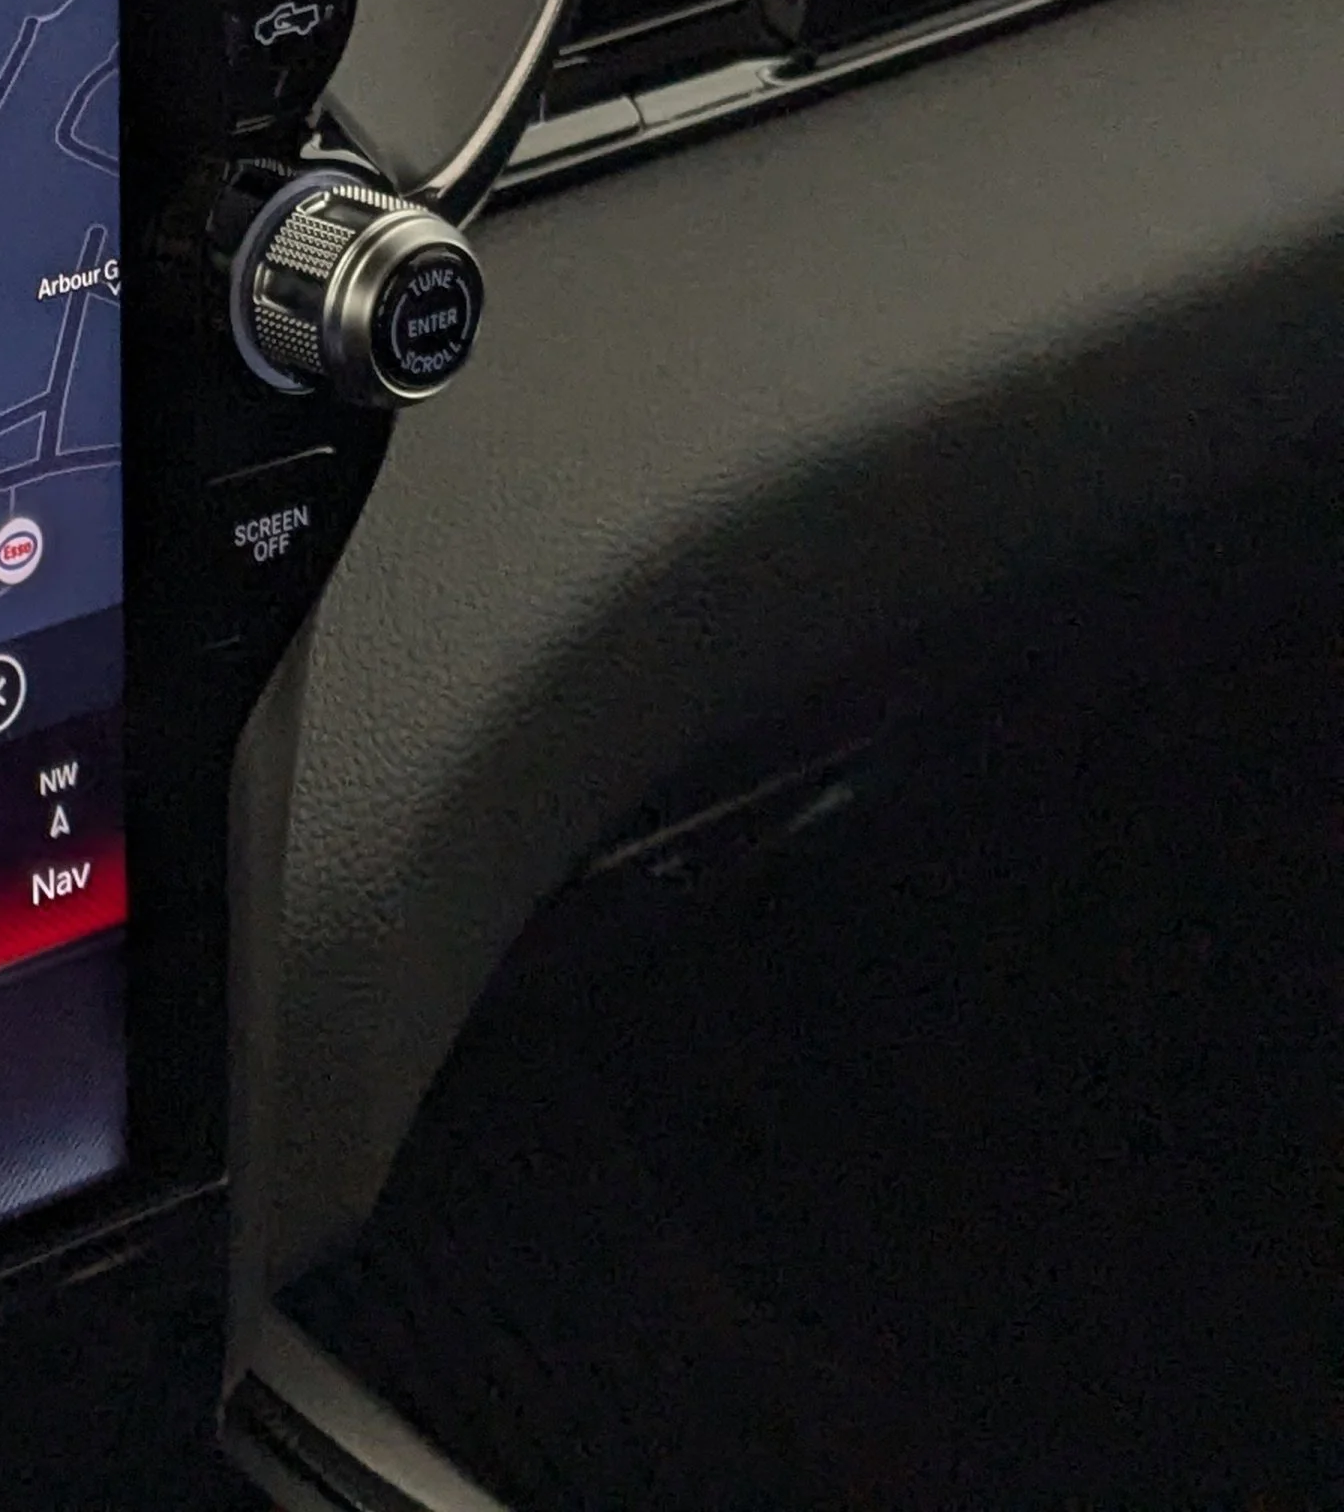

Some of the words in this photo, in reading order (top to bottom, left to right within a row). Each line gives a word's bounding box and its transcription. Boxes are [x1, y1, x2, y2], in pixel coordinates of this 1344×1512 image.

[38, 268, 101, 300] Arbour
[408, 270, 454, 298] TUNE
[407, 307, 458, 338] ENTER
[400, 340, 462, 375] SCROLL
[234, 505, 309, 548] SCREEN
[253, 533, 291, 563] OFF
[39, 762, 78, 796] NW
[31, 862, 90, 906] Nav
